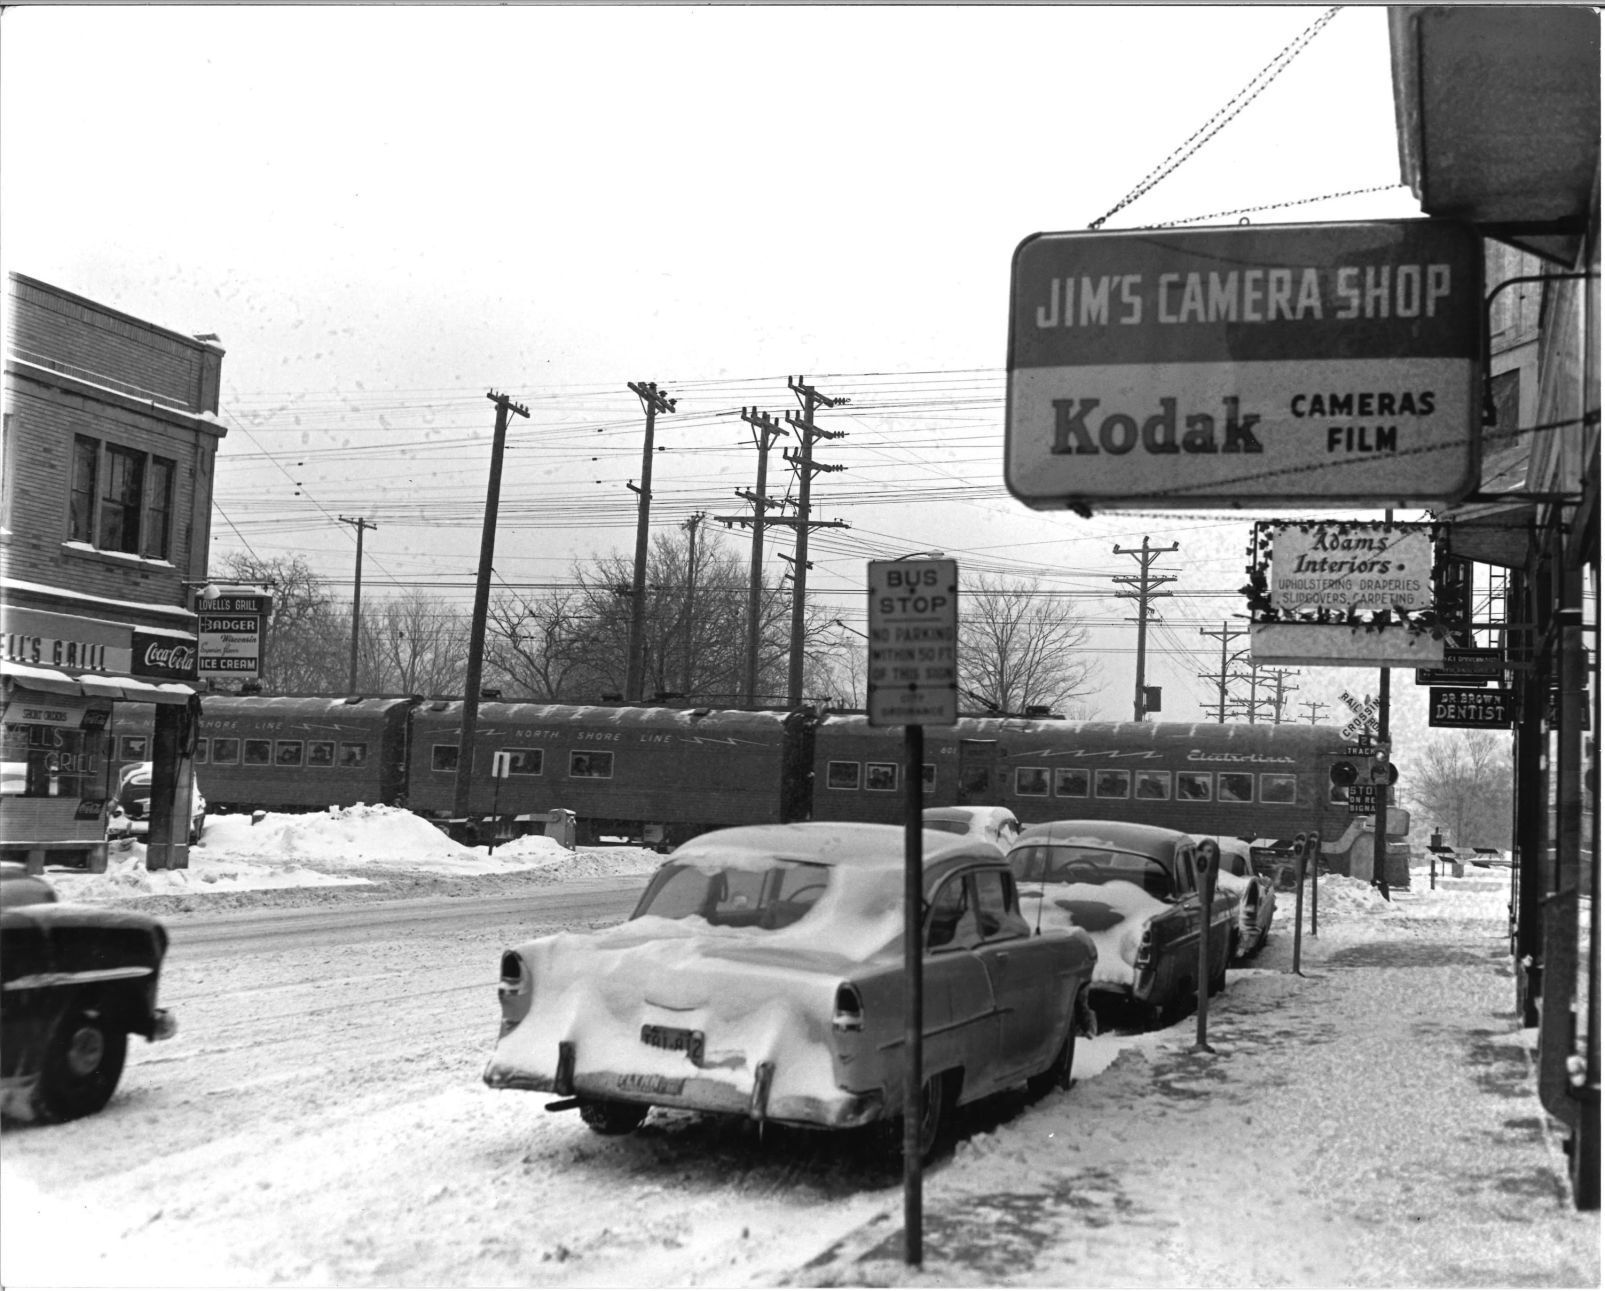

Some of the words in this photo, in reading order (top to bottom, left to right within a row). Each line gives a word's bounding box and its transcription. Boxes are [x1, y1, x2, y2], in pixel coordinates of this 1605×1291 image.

[1036, 274, 1142, 328] JIM'S
[1157, 267, 1324, 323] CAMERA
[1336, 264, 1451, 320] SHOP
[1290, 391, 1436, 418] CAMERAS
[1050, 396, 1264, 456] Kodak
[1327, 426, 1397, 452] FILM
[1312, 533, 1389, 552] Adams
[1293, 553, 1392, 574] Interiors
[886, 569, 937, 588] BUS
[1278, 578, 1352, 591] UPHOLSTERING
[1359, 579, 1421, 591] DRAPERIES
[235, 599, 258, 611] GRILL
[879, 596, 946, 614] STOP
[205, 619, 255, 631] BADGER
[895, 626, 953, 643] PARKING
[52, 638, 105, 672] GRILL
[201, 659, 217, 669] ICE
[220, 659, 256, 669] CREAM
[1460, 692, 1502, 704] BROWN
[1342, 698, 1381, 738] CROSSIN
[1435, 704, 1505, 721] DENTIST
[255, 722, 281, 730] LINE
[515, 729, 560, 739] NORTH
[577, 732, 622, 742] SHORE
[640, 735, 673, 743] LINE
[1360, 736, 1369, 746] 2
[1187, 749, 1296, 763] Electroliner
[1350, 785, 1377, 796] STO
[1350, 796, 1362, 804] ON
[1350, 804, 1377, 813] SIGNA
